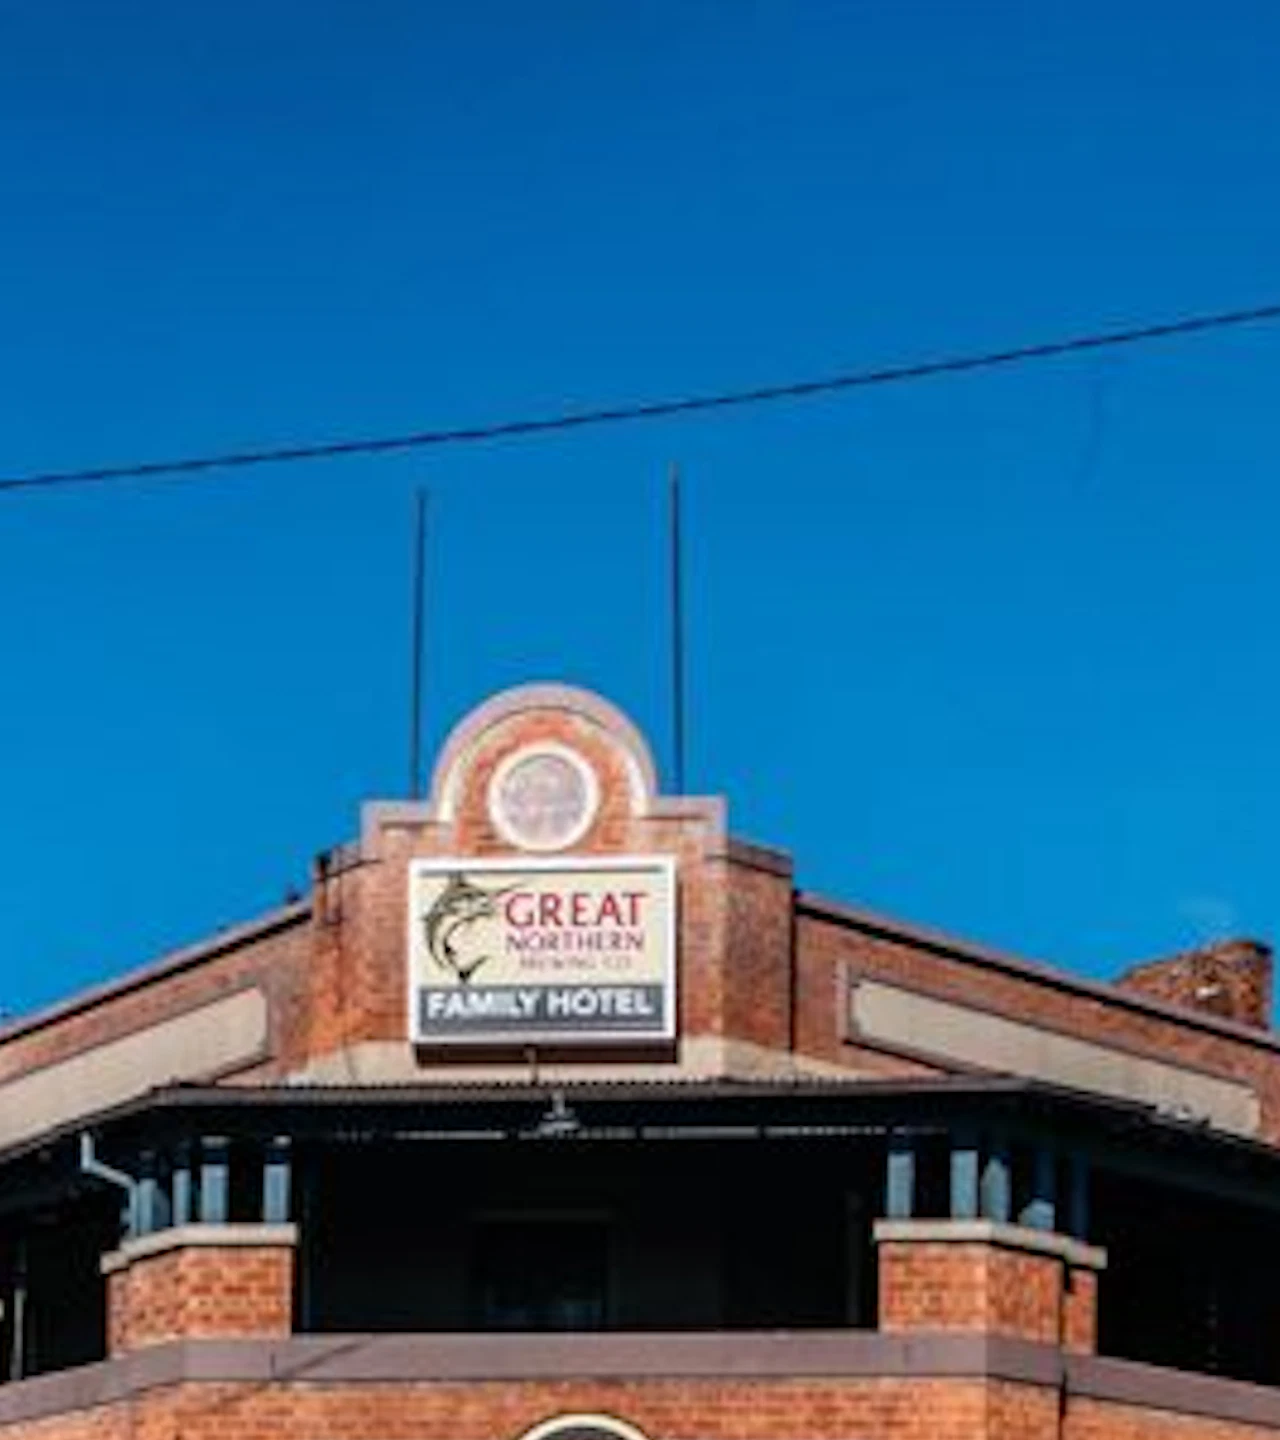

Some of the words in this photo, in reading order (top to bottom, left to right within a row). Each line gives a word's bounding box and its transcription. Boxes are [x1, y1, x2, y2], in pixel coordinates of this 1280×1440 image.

[505, 892, 649, 928] GREAT
[506, 931, 645, 952] NORTHERN
[427, 988, 540, 1019] FAMILY
[547, 986, 655, 1016] HOTEL
